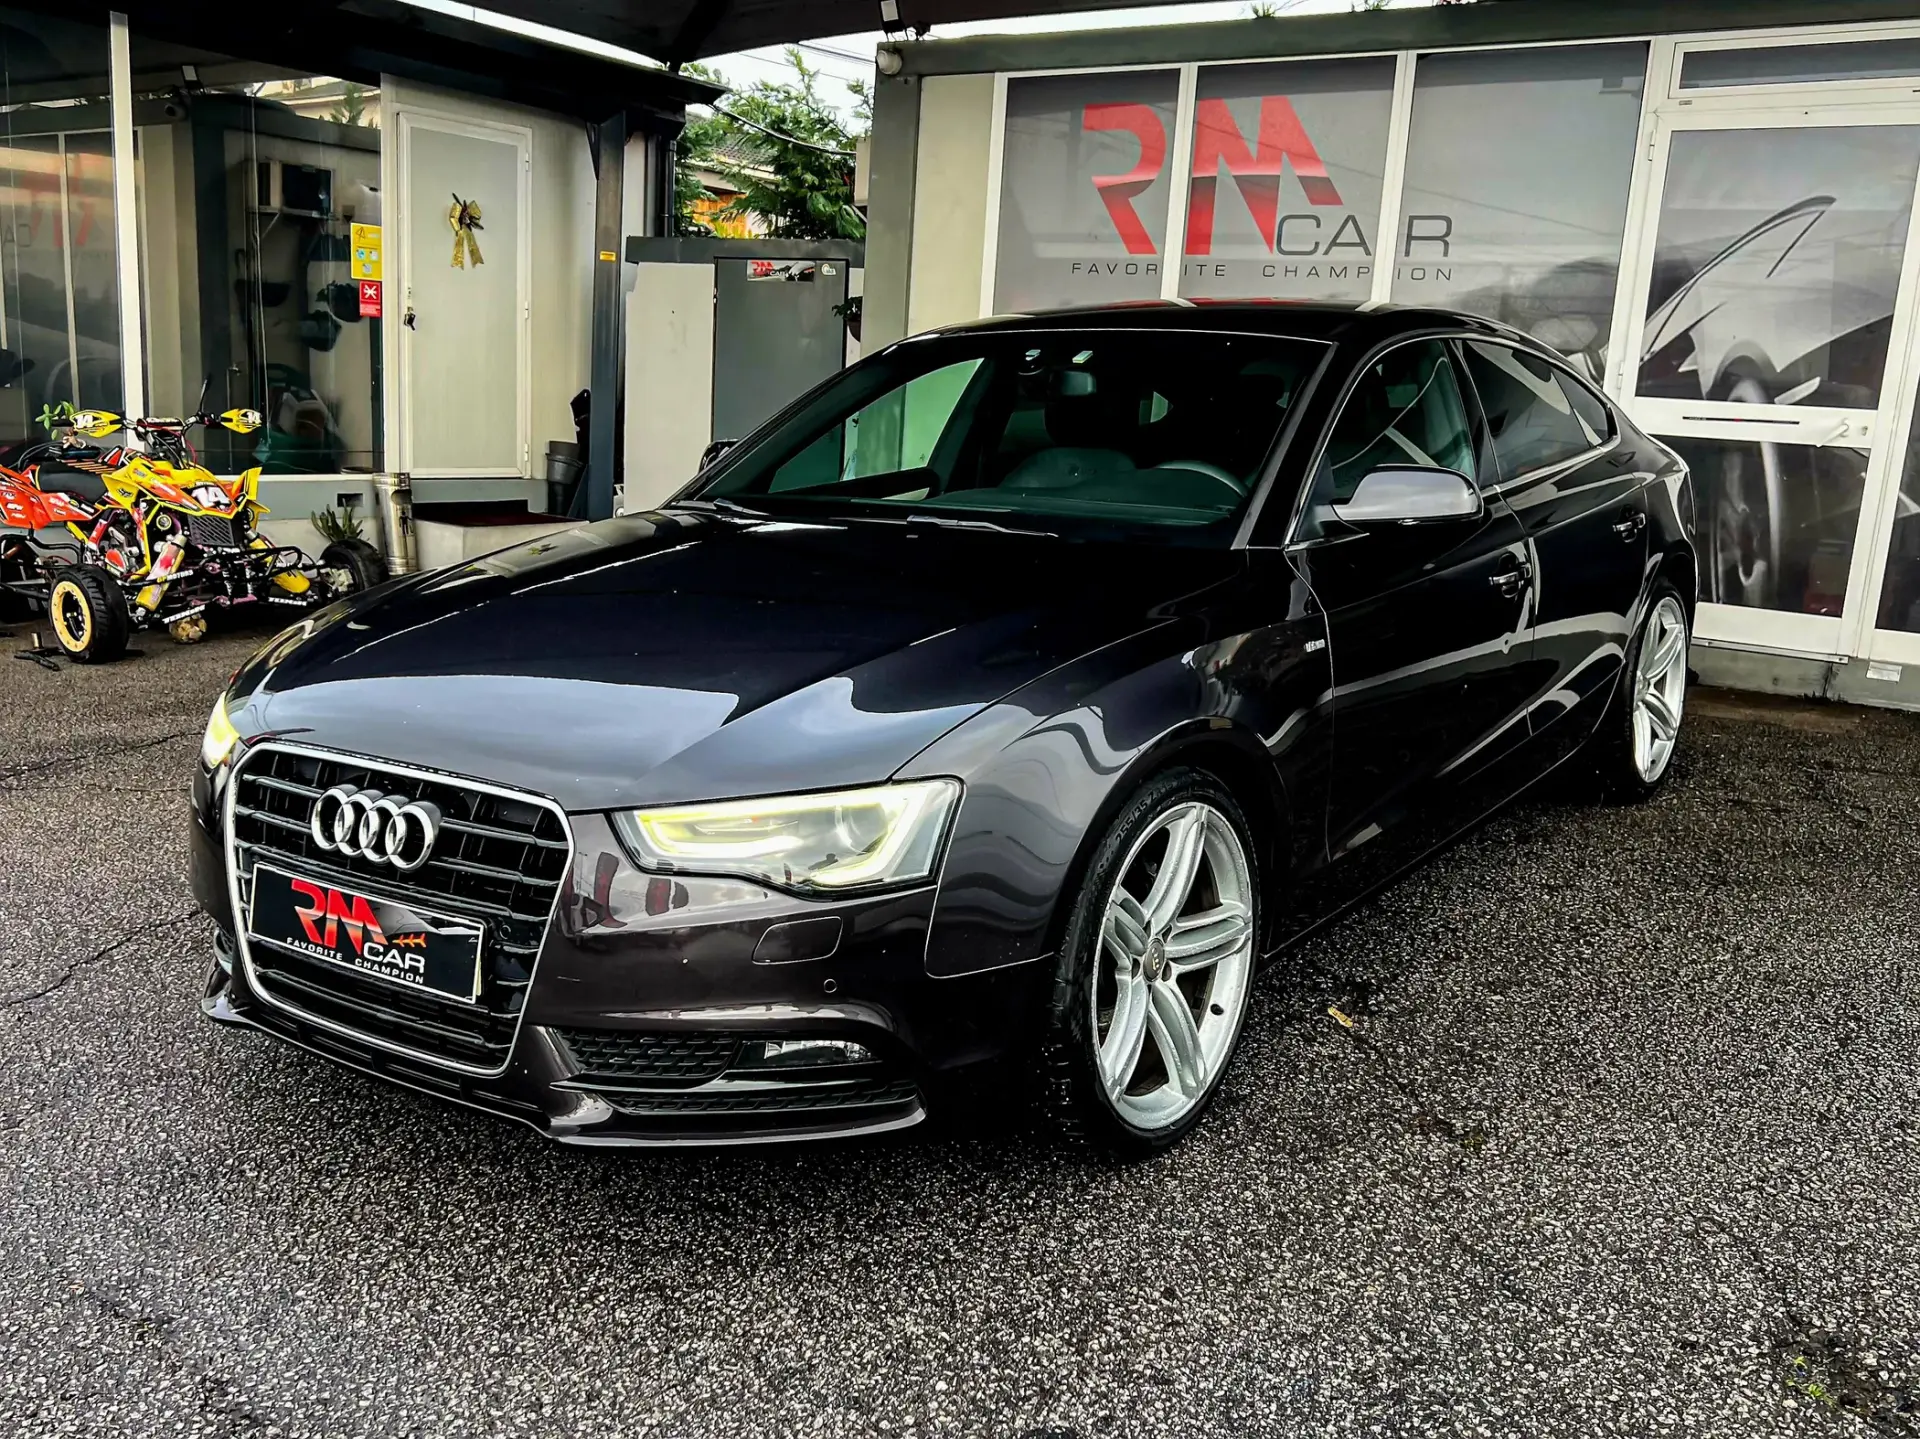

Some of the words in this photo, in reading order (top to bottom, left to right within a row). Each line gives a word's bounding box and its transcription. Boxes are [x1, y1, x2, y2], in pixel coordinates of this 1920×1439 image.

[1083, 95, 1344, 256] RM
[1276, 214, 1453, 257] CAR
[1072, 262, 1226, 277] FAVORITE
[1262, 264, 1452, 281] CHAMPION
[291, 878, 388, 955] RM
[286, 937, 343, 961] FAVORITE
[354, 958, 424, 984] CHAMPION
[363, 941, 426, 974] CAR
